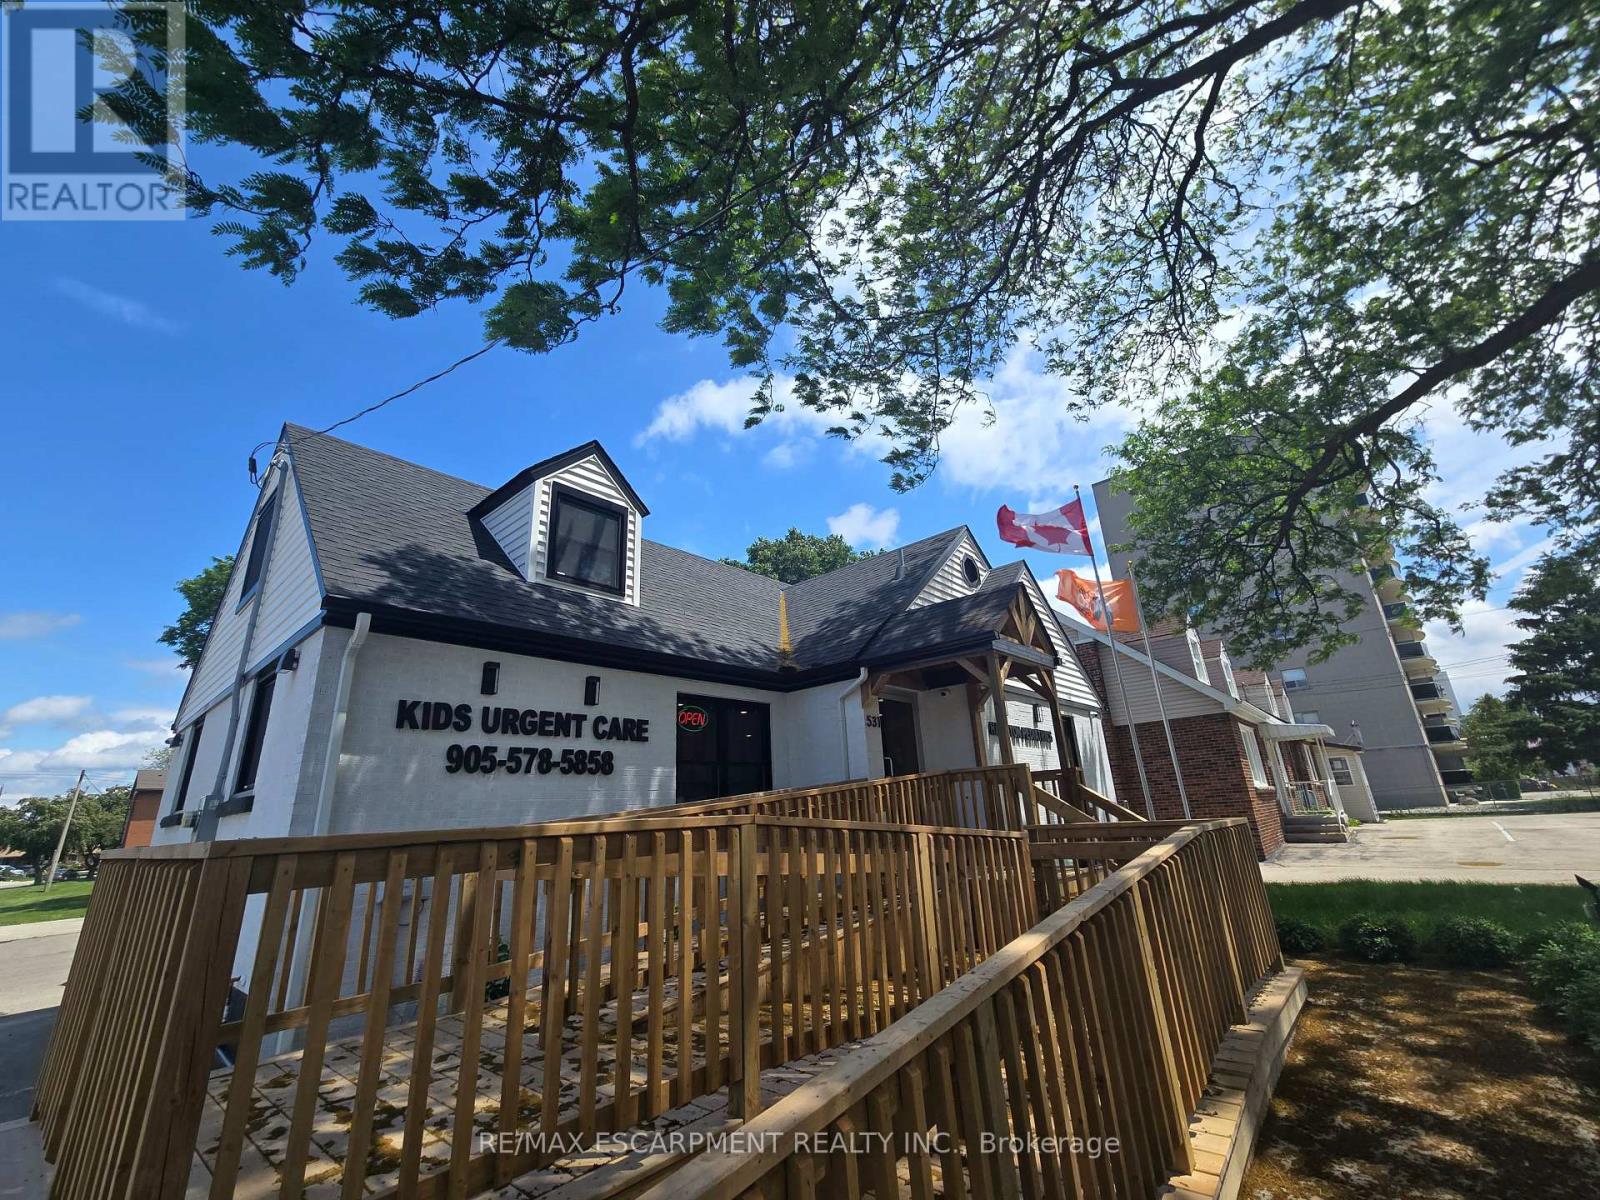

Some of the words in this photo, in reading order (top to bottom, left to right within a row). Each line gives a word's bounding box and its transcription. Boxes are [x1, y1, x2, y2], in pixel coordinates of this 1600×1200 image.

[396, 700, 472, 732] KIDS
[481, 706, 587, 738] URGENT
[593, 716, 649, 742] CARE
[679, 712, 705, 726] OPEN
[445, 744, 614, 775] 905-578-5858
